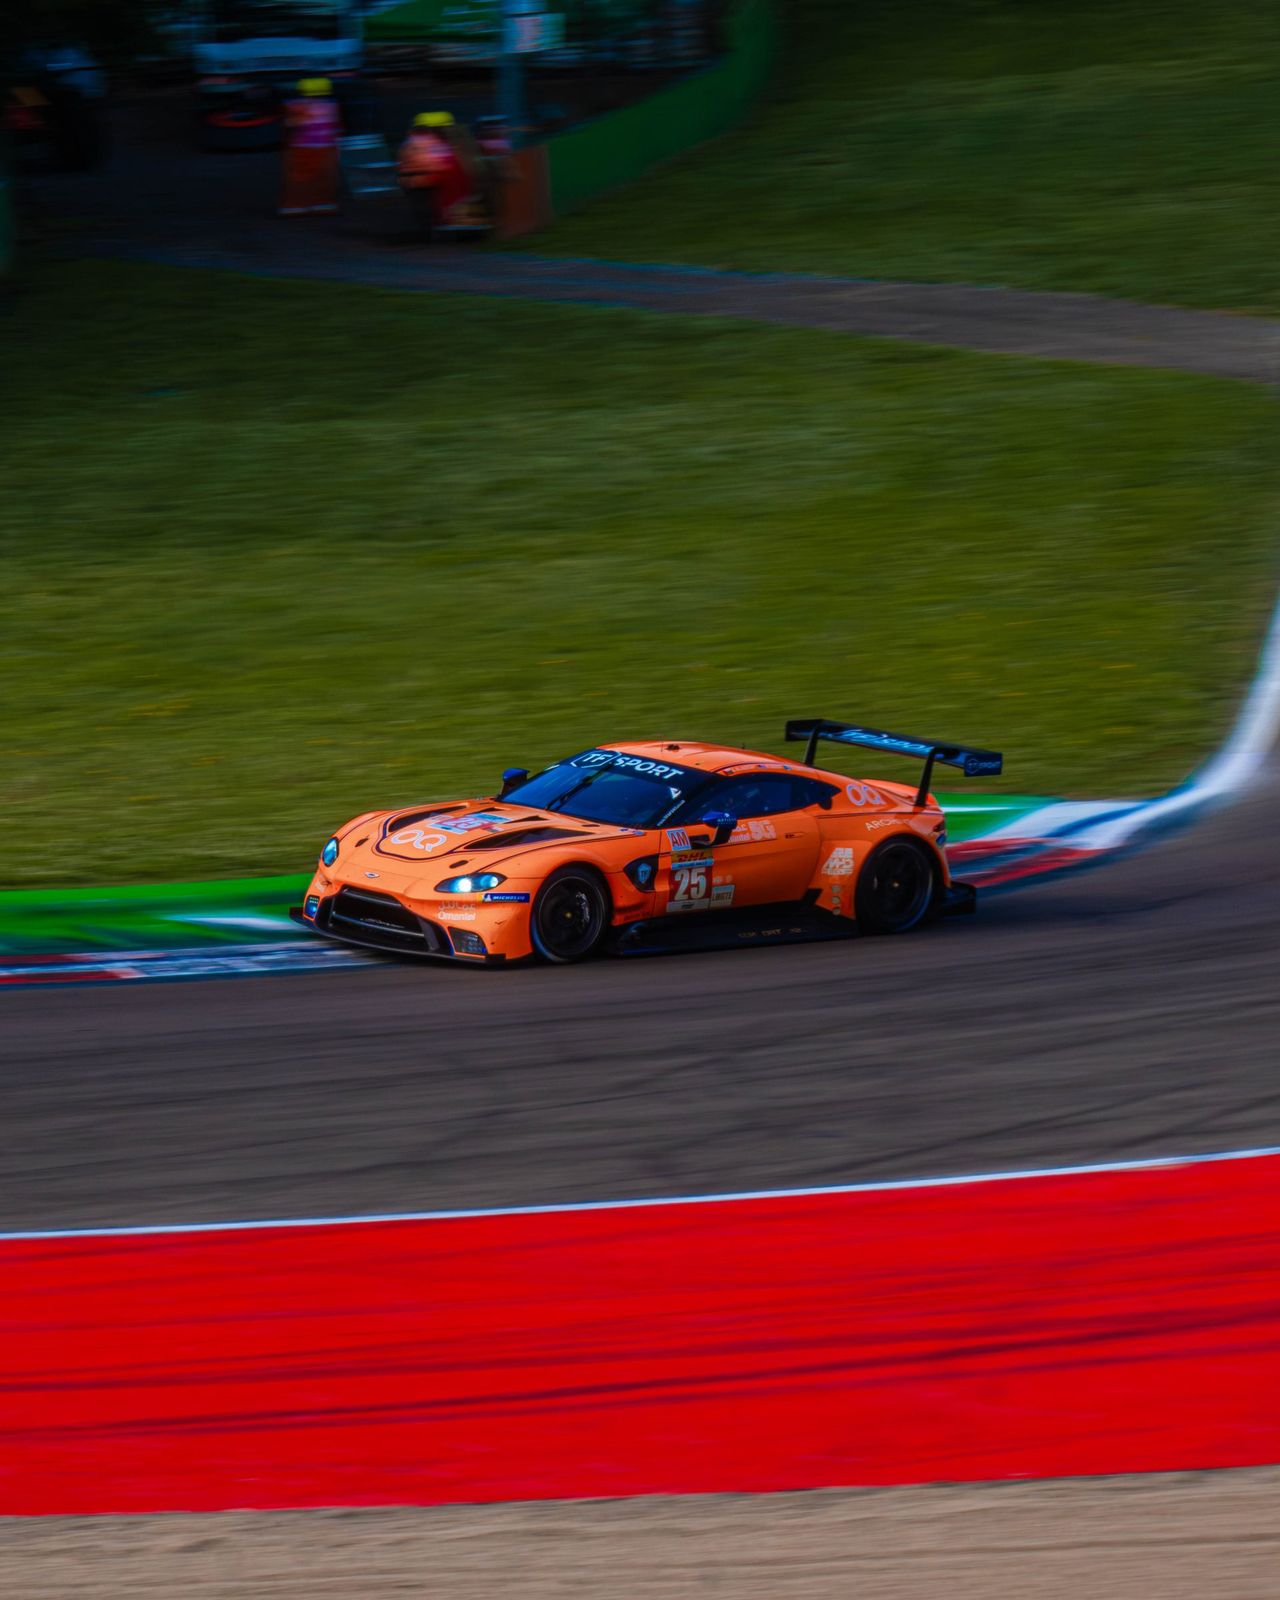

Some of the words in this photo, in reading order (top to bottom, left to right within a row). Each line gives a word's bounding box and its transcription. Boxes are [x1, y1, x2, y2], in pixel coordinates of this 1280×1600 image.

[582, 753, 613, 763] TF
[614, 756, 685, 780] SPORT
[669, 831, 690, 848] AM
[673, 867, 707, 901] 25
